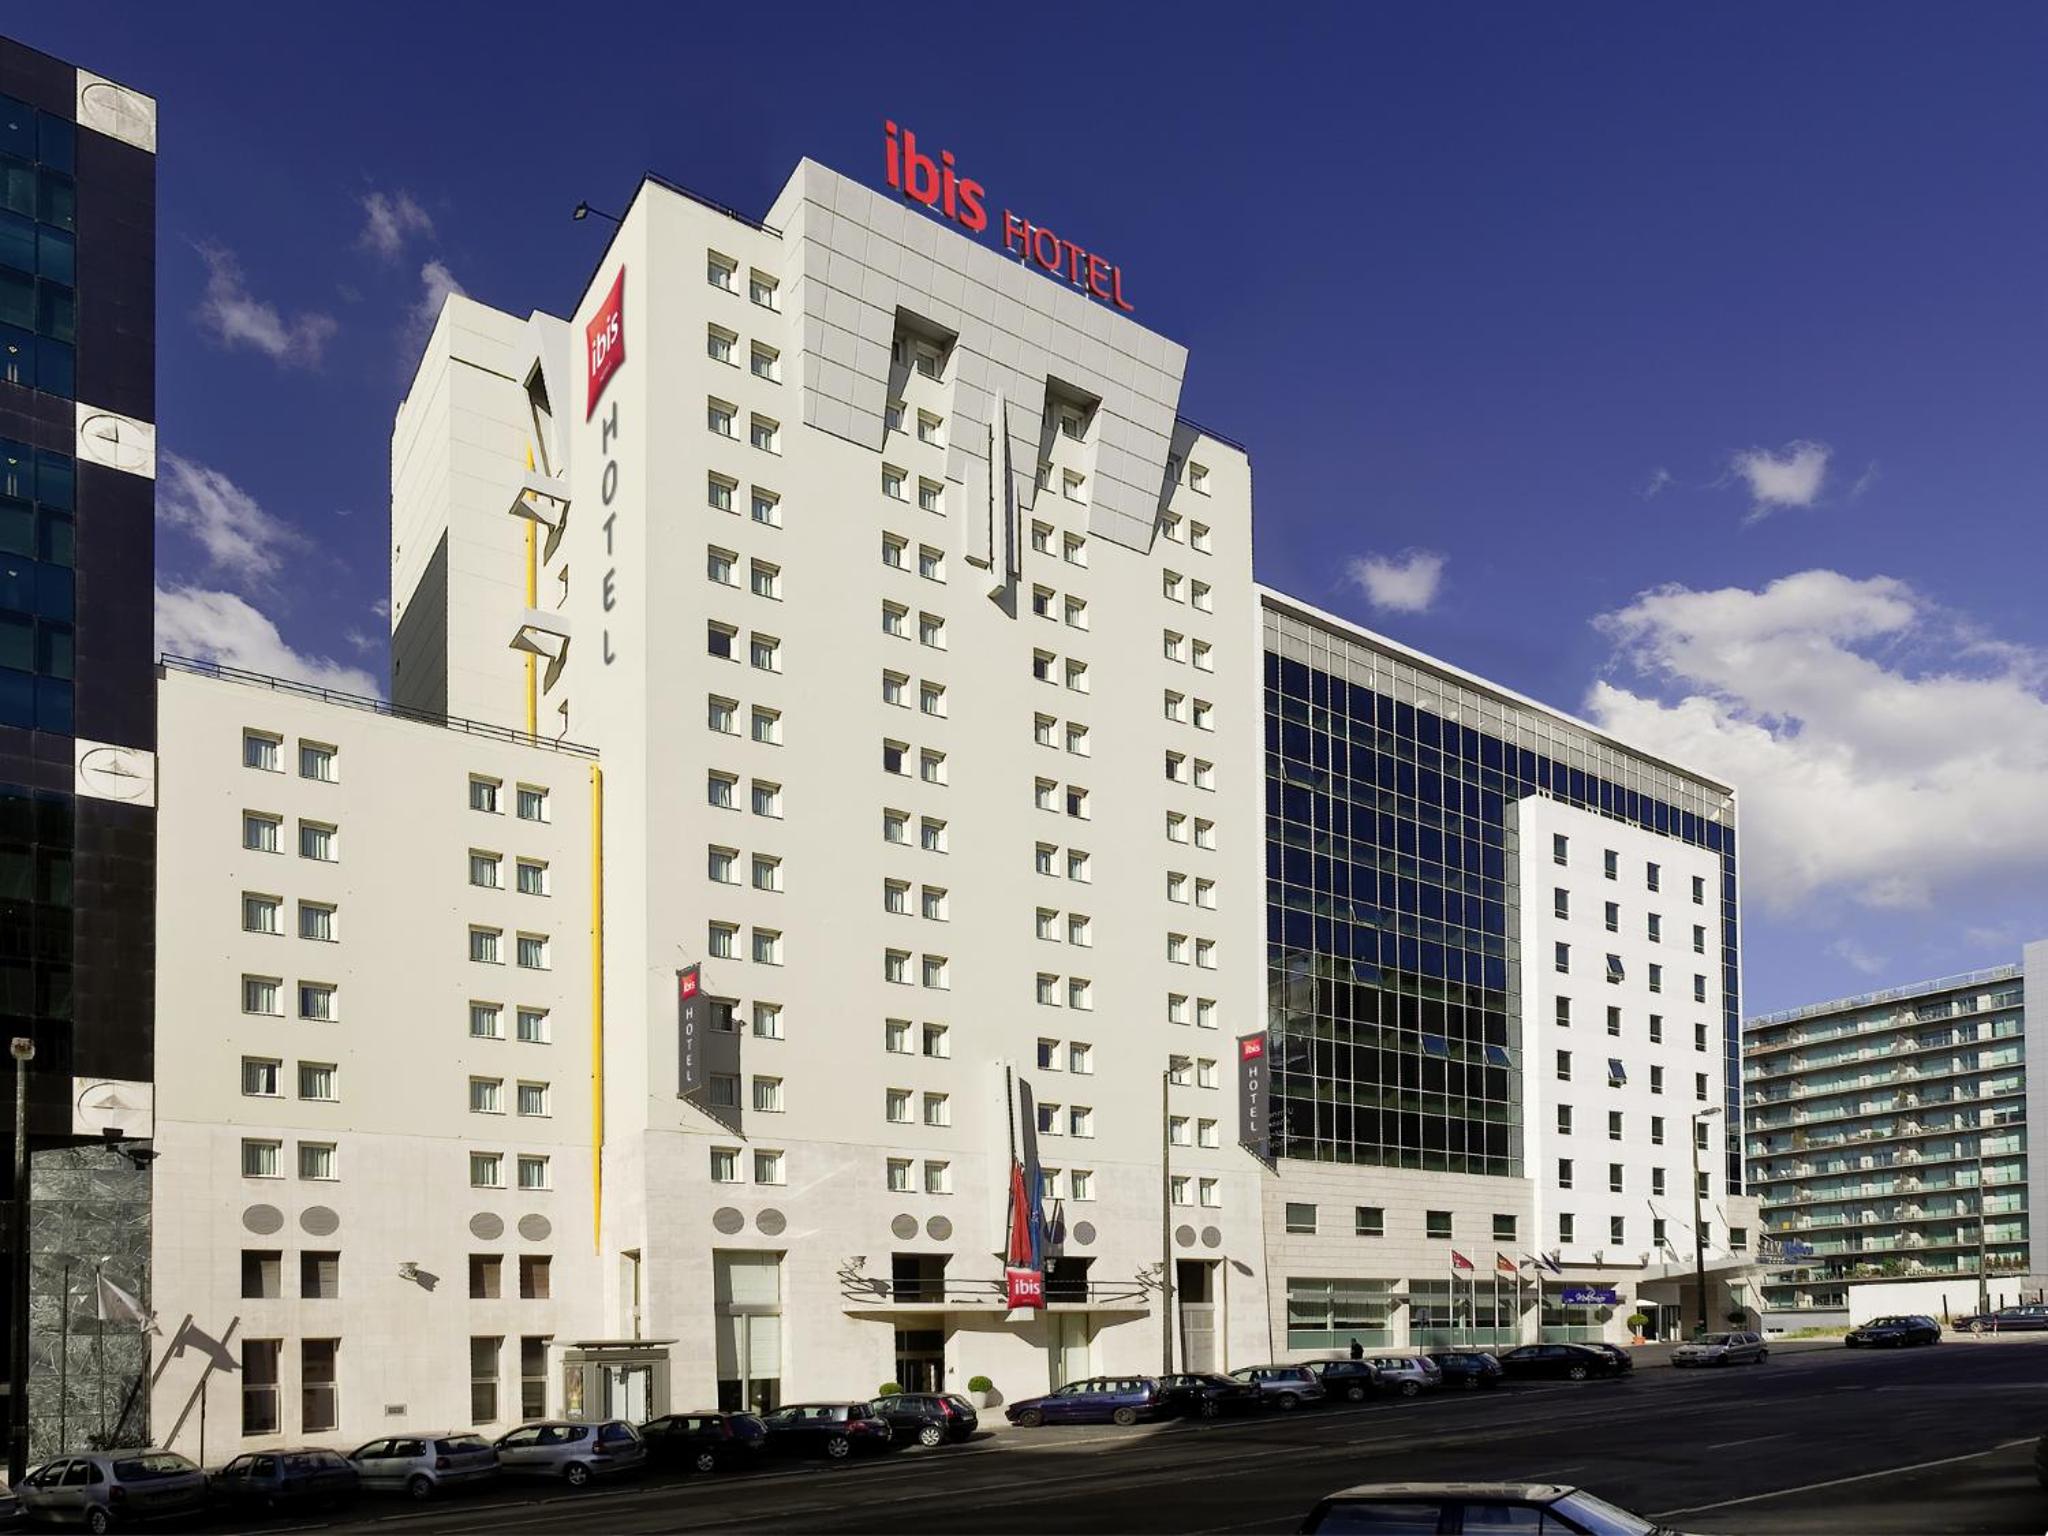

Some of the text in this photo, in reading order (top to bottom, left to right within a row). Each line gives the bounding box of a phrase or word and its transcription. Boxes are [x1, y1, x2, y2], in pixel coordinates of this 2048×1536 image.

[885, 119, 1135, 312] ibis HOTEL
[592, 311, 619, 377] ibis
[602, 400, 618, 666] HOTEL
[685, 1006, 694, 1083] HOTEL
[1248, 1065, 1259, 1132] HOTEL
[1014, 1279, 1041, 1296] ibis
